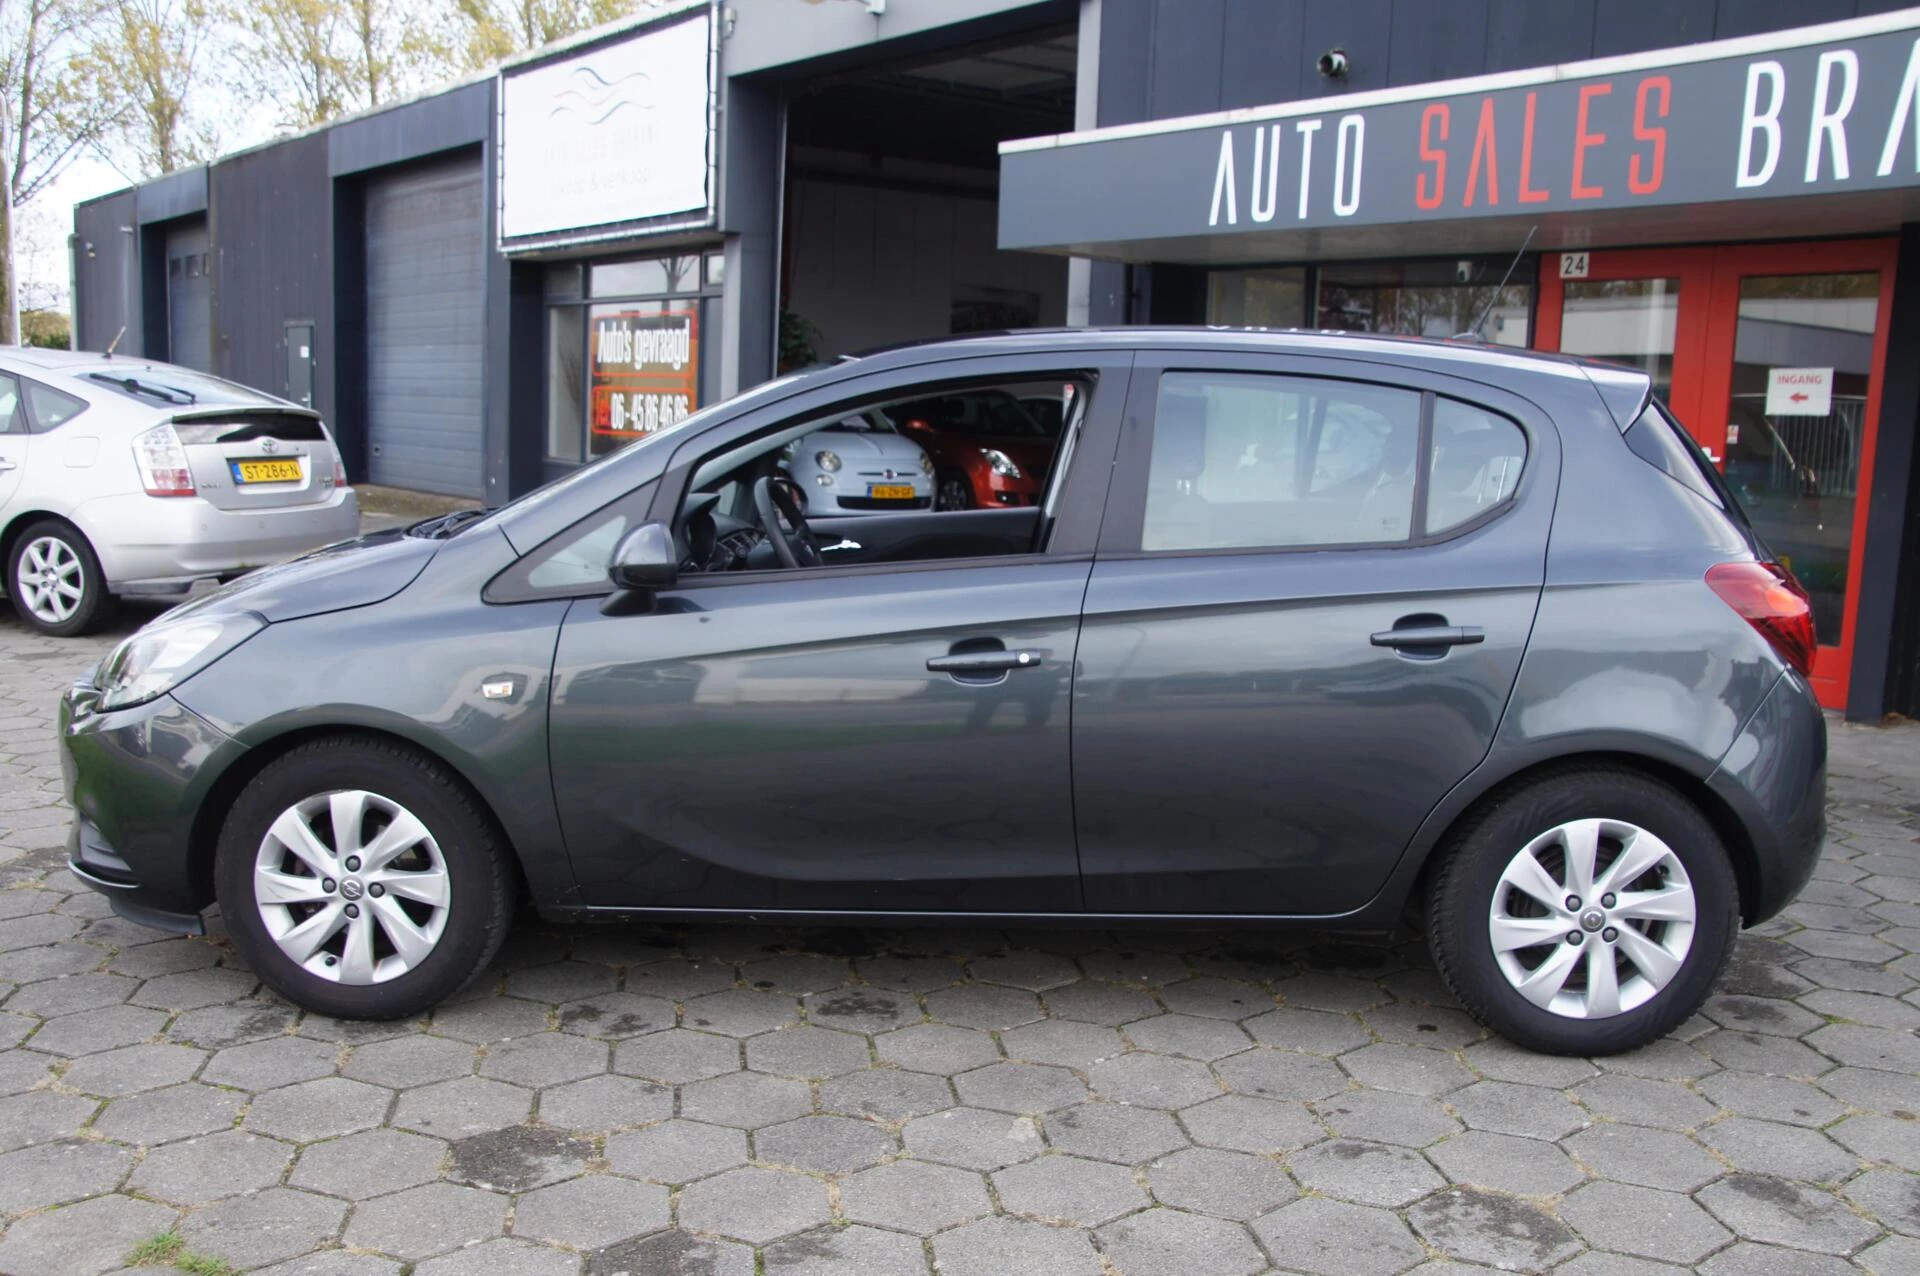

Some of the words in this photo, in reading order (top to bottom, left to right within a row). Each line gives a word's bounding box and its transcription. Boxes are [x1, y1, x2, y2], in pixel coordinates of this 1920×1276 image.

[1208, 114, 1364, 226] AUTO
[1415, 76, 1671, 210] SALES
[1564, 255, 1584, 274] 24
[597, 320, 632, 363] Auto's
[634, 318, 690, 370] gevraagd
[1777, 375, 1823, 385] INGANG
[244, 464, 300, 480] ST-286-N
